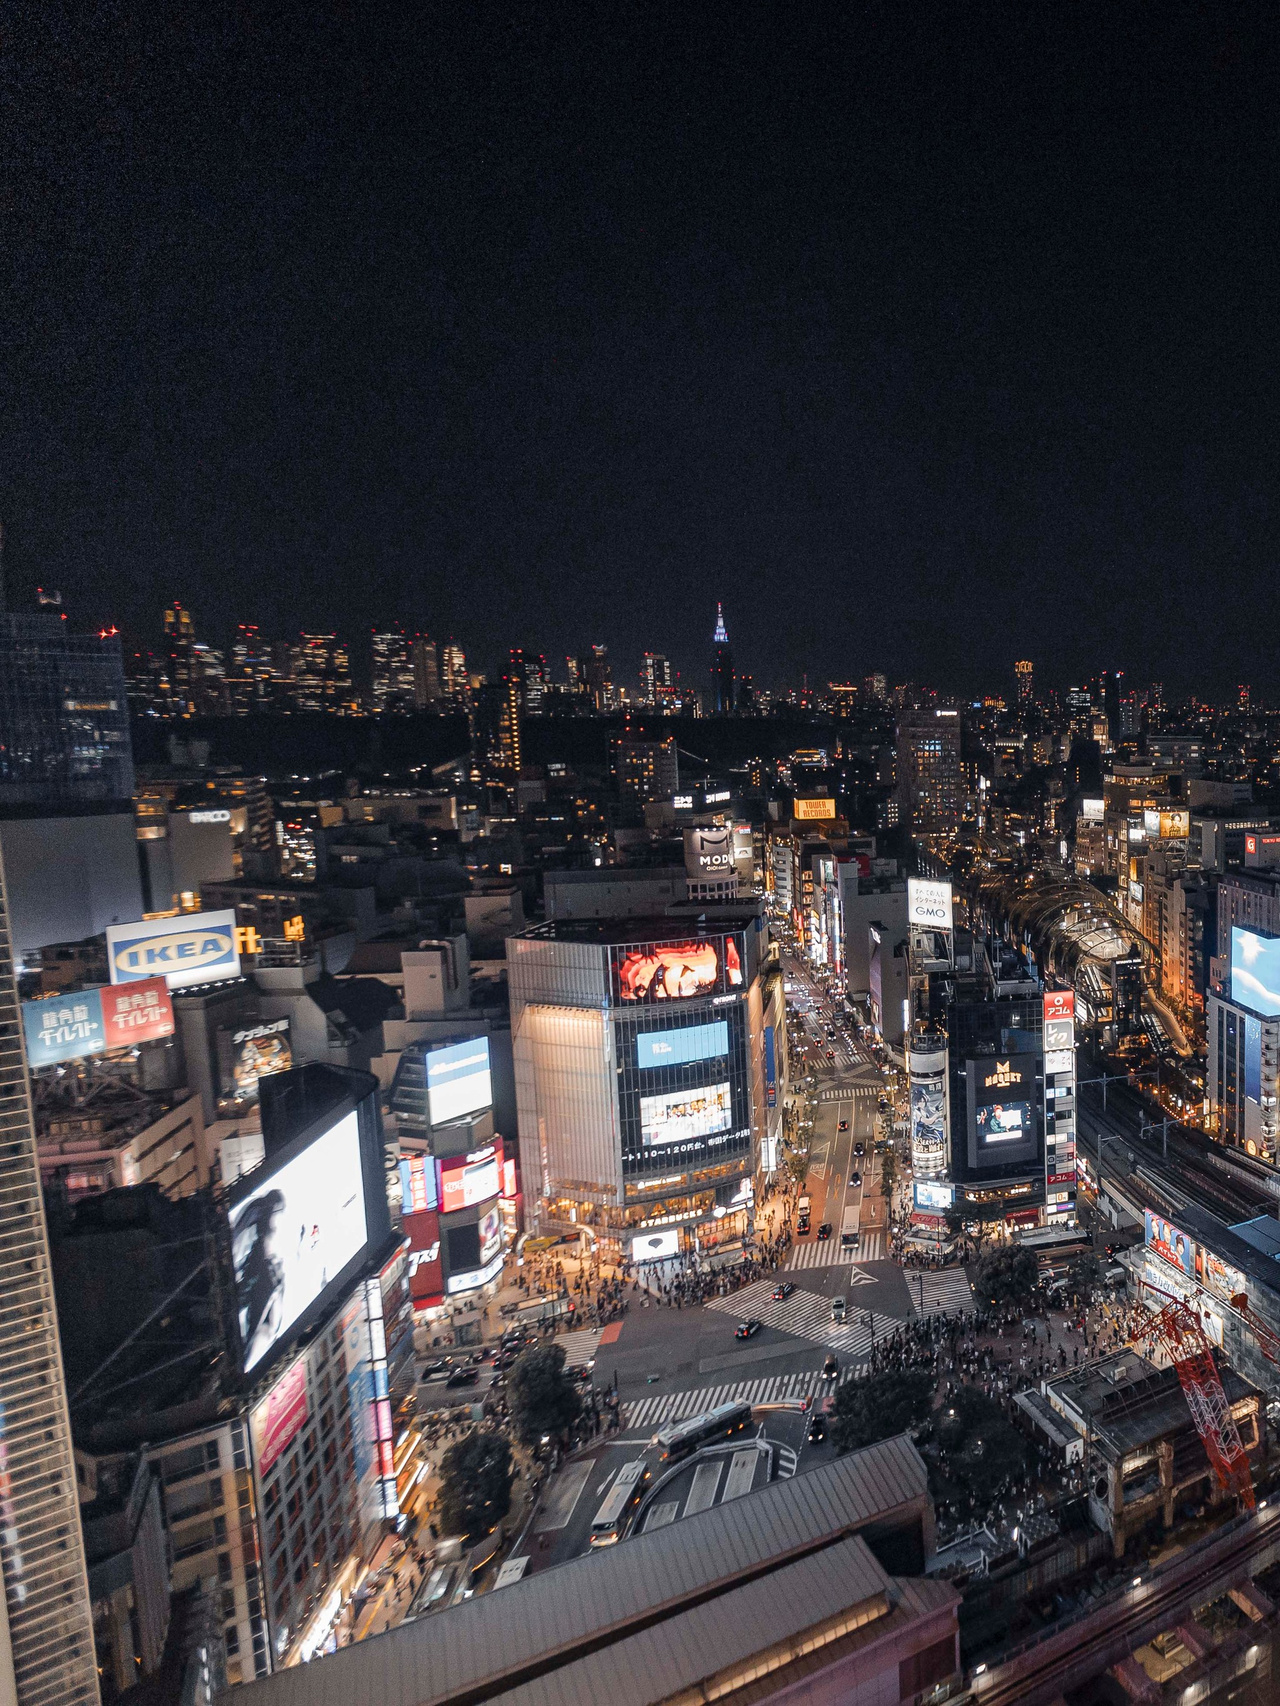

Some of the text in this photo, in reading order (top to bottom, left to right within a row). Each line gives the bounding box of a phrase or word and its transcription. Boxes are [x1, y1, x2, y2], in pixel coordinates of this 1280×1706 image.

[805, 801, 827, 809] TOWER
[803, 809, 831, 818] RECORDS
[915, 896, 946, 906] インターネット
[915, 906, 946, 918] GMO
[127, 937, 225, 968] IKEA
[1047, 1006, 1071, 1016] アコム
[1050, 1175, 1067, 1183] アコム
[640, 1208, 703, 1228] STARBUCKS
